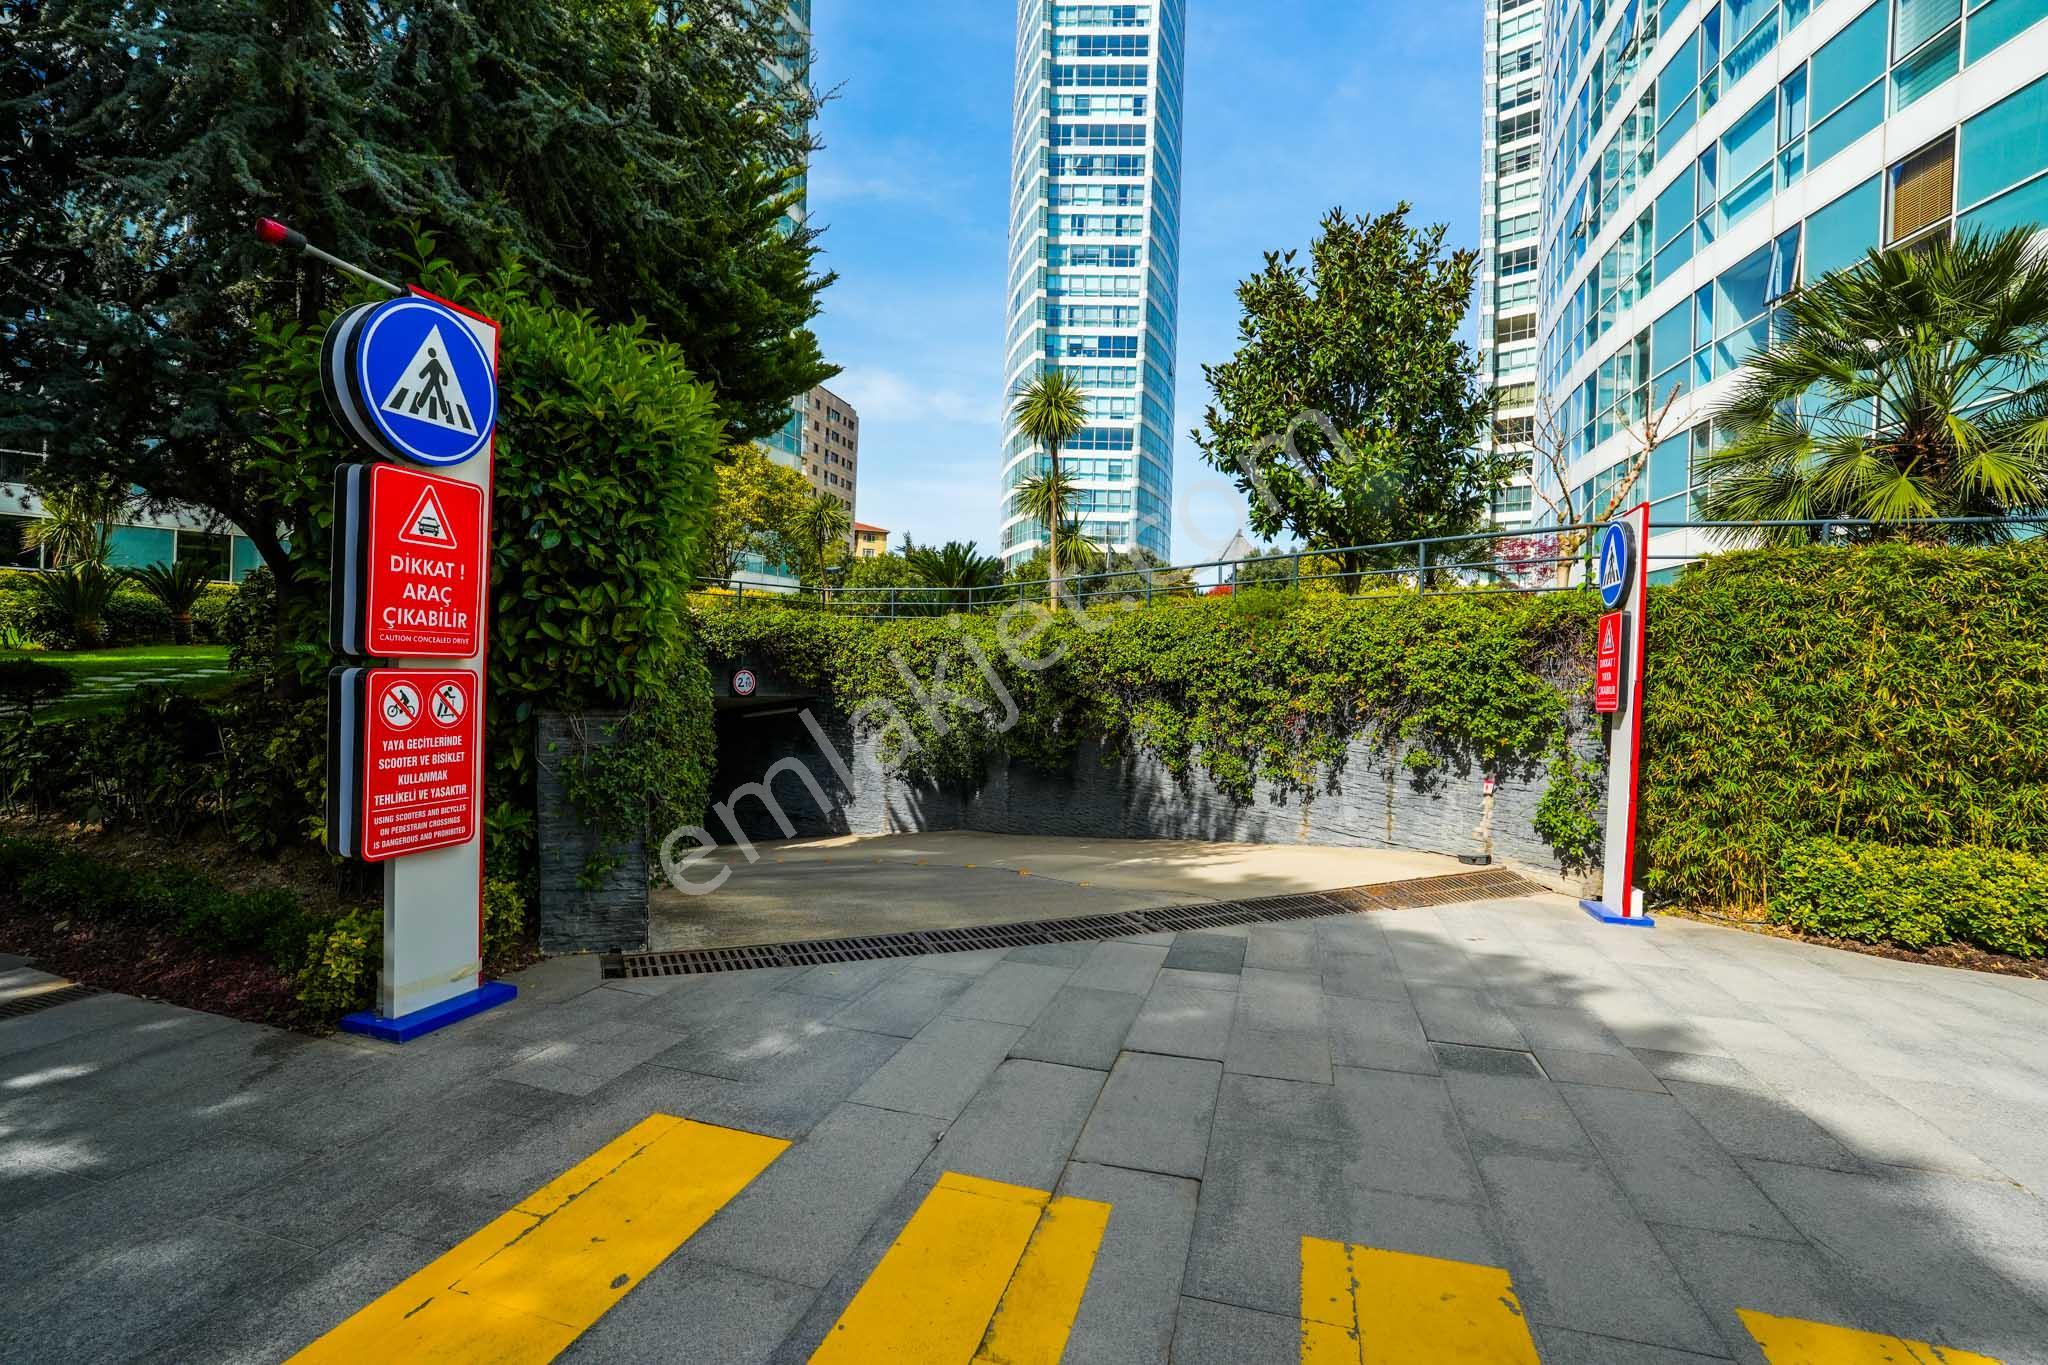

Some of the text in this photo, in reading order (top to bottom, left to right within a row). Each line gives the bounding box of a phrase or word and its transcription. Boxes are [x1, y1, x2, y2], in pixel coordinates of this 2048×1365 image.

[390, 552, 455, 578] DİKKAT
[402, 582, 453, 607] ARAÇ
[383, 607, 468, 629] ÇIKABİLİR
[379, 633, 470, 645] CAUTION CONCEALED DRIVE
[382, 739, 404, 751] YAYA
[378, 751, 465, 769] SCOOTER VE BİSİKLET
[398, 770, 448, 785] KULLANMAK
[374, 784, 467, 806] TEHLİKELİ VE YASAKTIR
[374, 804, 466, 825] USING SCOOTERS AND BICYCLES
[380, 827, 390, 837] ON
[428, 816, 461, 828] CROSSINGS
[373, 841, 380, 849] IS
[381, 835, 419, 848] DANGEROUS
[420, 832, 433, 840] AND
